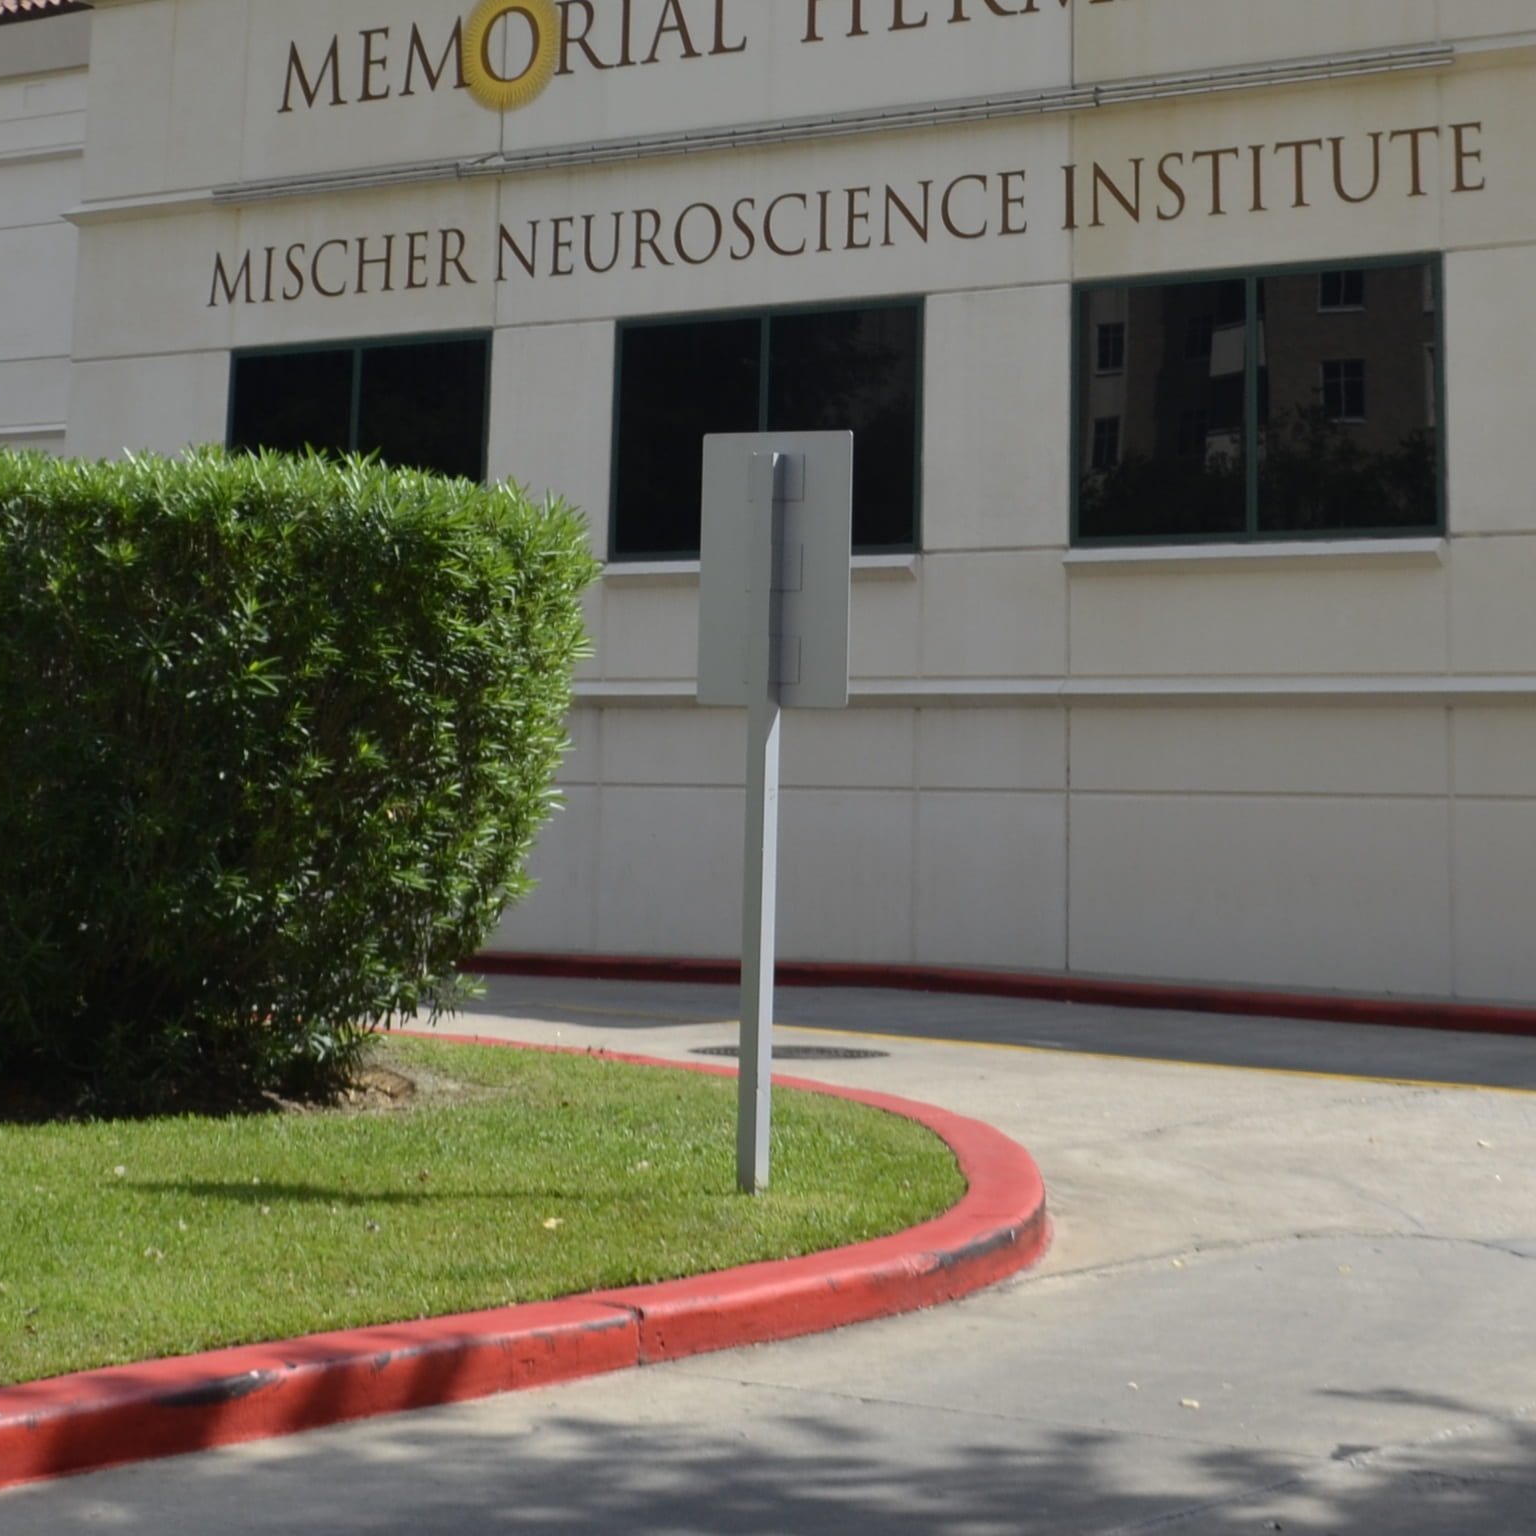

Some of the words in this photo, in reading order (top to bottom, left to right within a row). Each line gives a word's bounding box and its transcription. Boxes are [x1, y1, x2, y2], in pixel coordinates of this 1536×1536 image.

[206, 227, 477, 308] MISCHER
[493, 168, 1028, 282] NEUROSCIENCE
[1060, 121, 1487, 231] INSTITUTE
